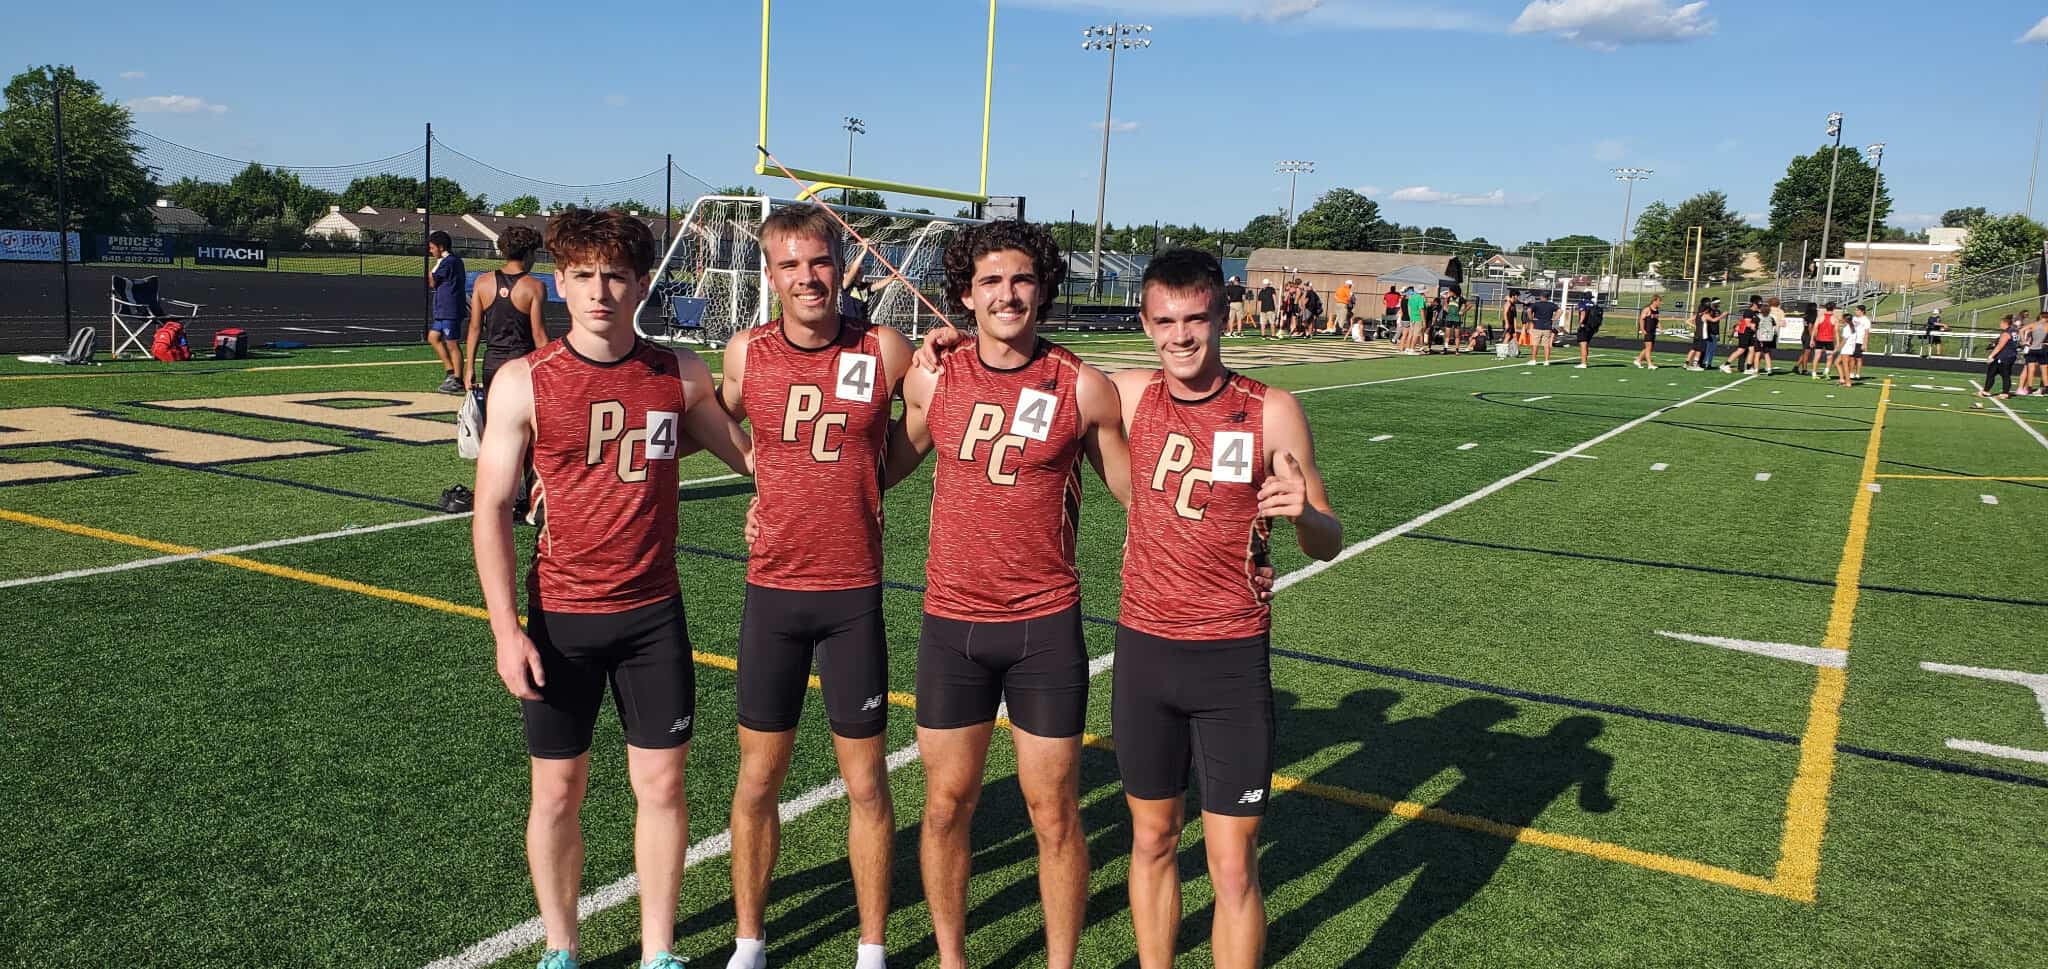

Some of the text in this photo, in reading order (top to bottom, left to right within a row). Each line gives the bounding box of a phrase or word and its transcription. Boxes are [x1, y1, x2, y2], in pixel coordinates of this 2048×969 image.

[108, 236, 163, 248] PRICE'S
[198, 246, 264, 260] HITACHI
[842, 360, 871, 396] 4
[1018, 398, 1048, 434] 4
[650, 418, 675, 454] 4
[1217, 438, 1249, 476] 4
